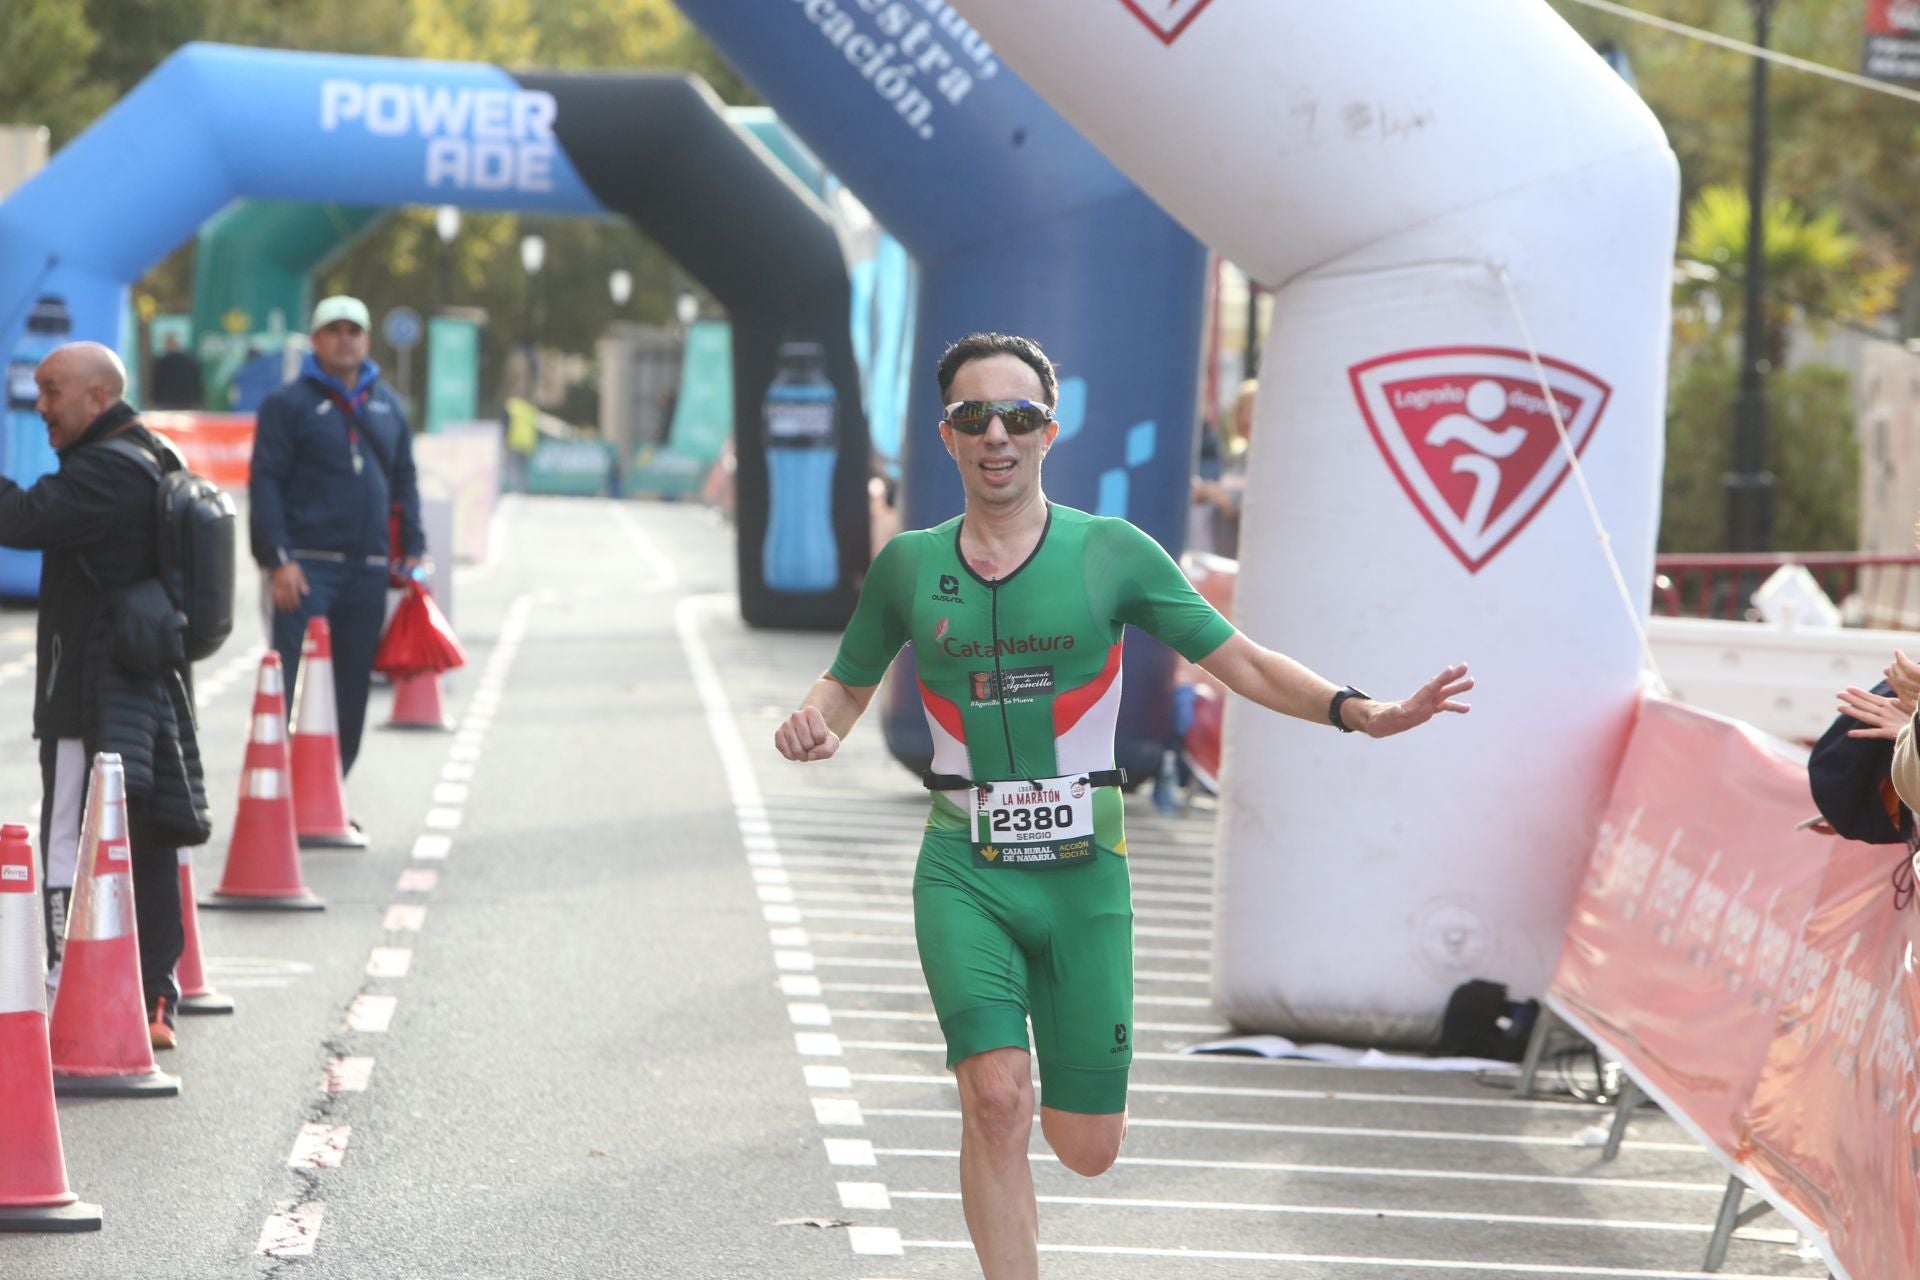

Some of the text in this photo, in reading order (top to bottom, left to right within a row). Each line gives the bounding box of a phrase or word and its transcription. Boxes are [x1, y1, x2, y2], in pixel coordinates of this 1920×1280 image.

[798, 0, 934, 140] cación.
[320, 79, 557, 139] POWER
[426, 136, 556, 191] ADE
[943, 634, 1075, 658] CataNatura
[1007, 678, 1053, 693] Agoncillo
[1002, 793, 1014, 806] LA
[1016, 789, 1061, 805] MARATÓN
[992, 804, 1073, 832] 2380
[1016, 832, 1052, 841] SERGIO
[1002, 846, 1053, 856] CAJA RURAL
[1059, 841, 1089, 851] ACCIÓN
[1059, 849, 1089, 859] SOCIAL
[1016, 853, 1057, 862] NAVARRA
